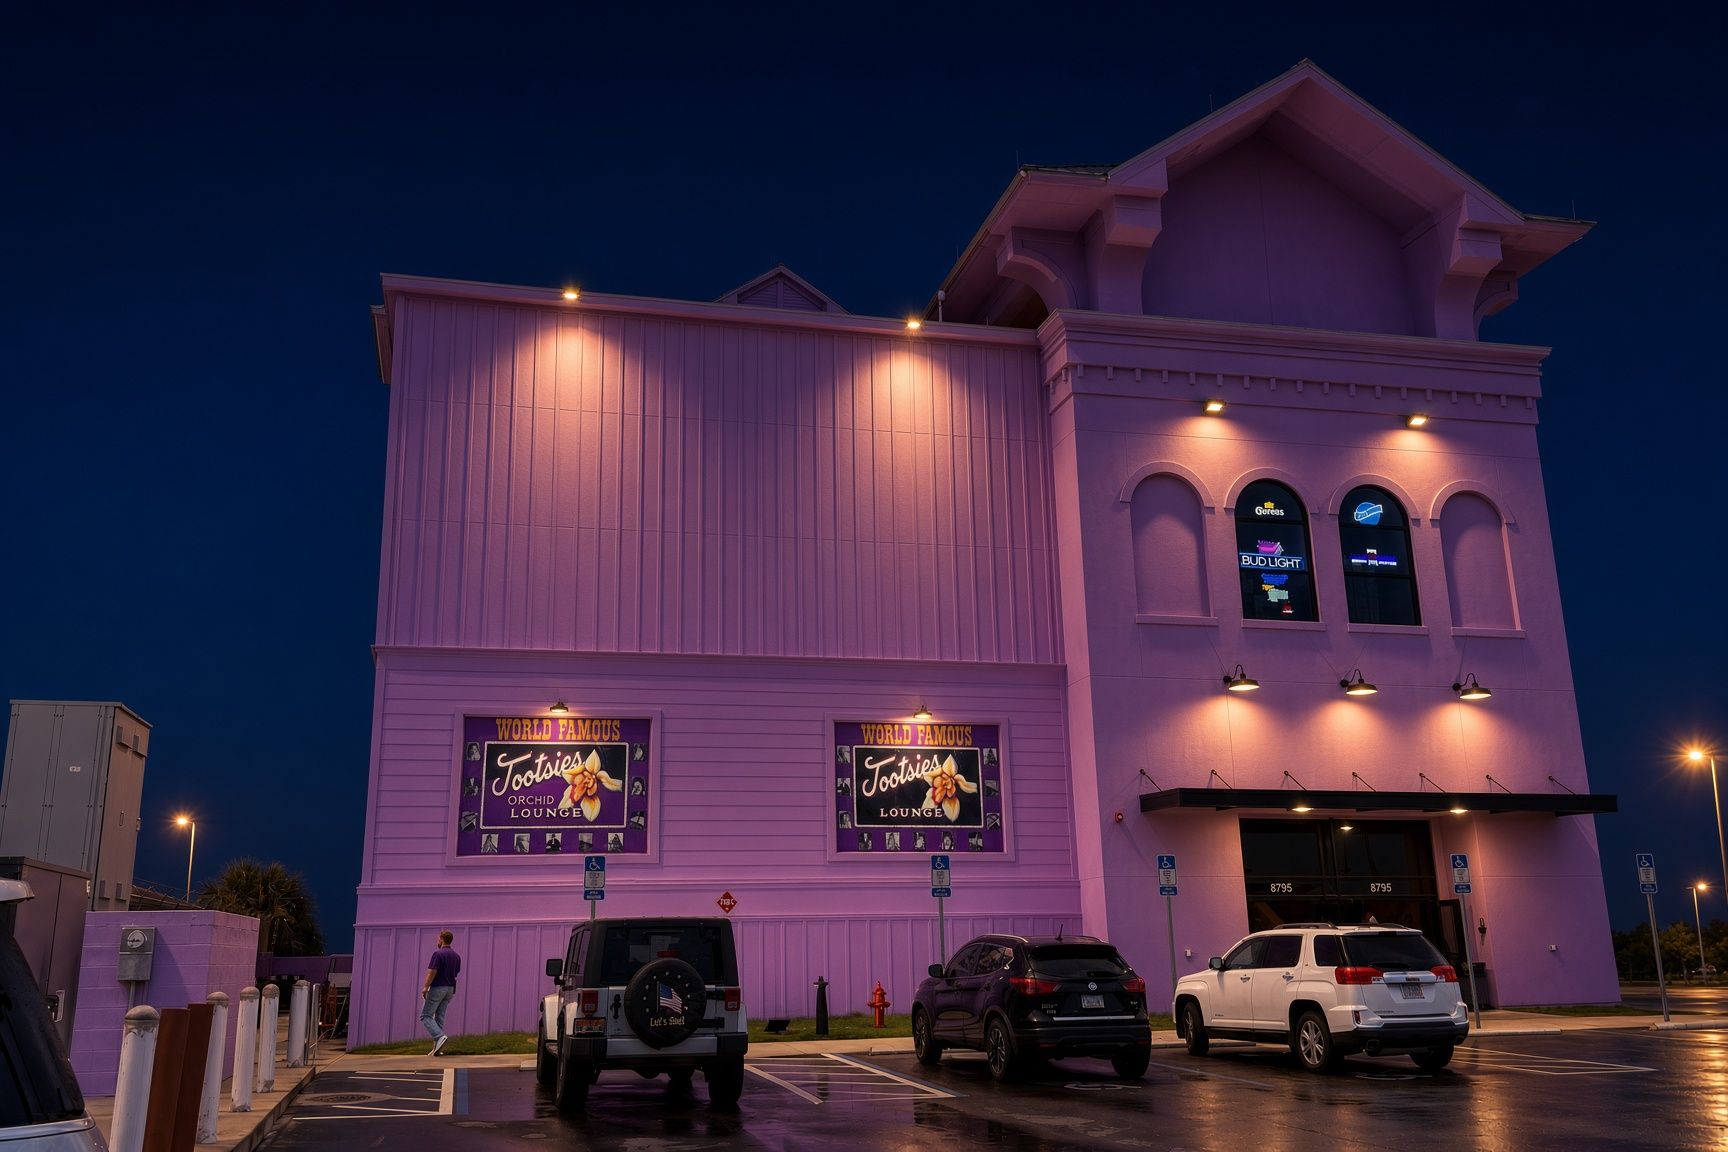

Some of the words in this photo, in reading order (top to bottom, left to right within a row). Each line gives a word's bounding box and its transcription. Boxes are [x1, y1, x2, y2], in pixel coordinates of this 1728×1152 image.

[1241, 555, 1267, 567] BUD
[1268, 557, 1302, 569] LIGHT
[496, 717, 552, 741] WORLD
[558, 719, 621, 742] FAMOUS
[861, 723, 912, 745] WORLD
[917, 725, 973, 747] FAMOUS
[492, 750, 586, 797] Tootsies
[862, 754, 942, 797] Tootsies
[507, 795, 555, 806] ORCHID
[510, 807, 583, 819] LOUNGE
[879, 807, 943, 818] LOUNGE
[1270, 883, 1293, 893] 8795
[1370, 883, 1392, 893] 8795
